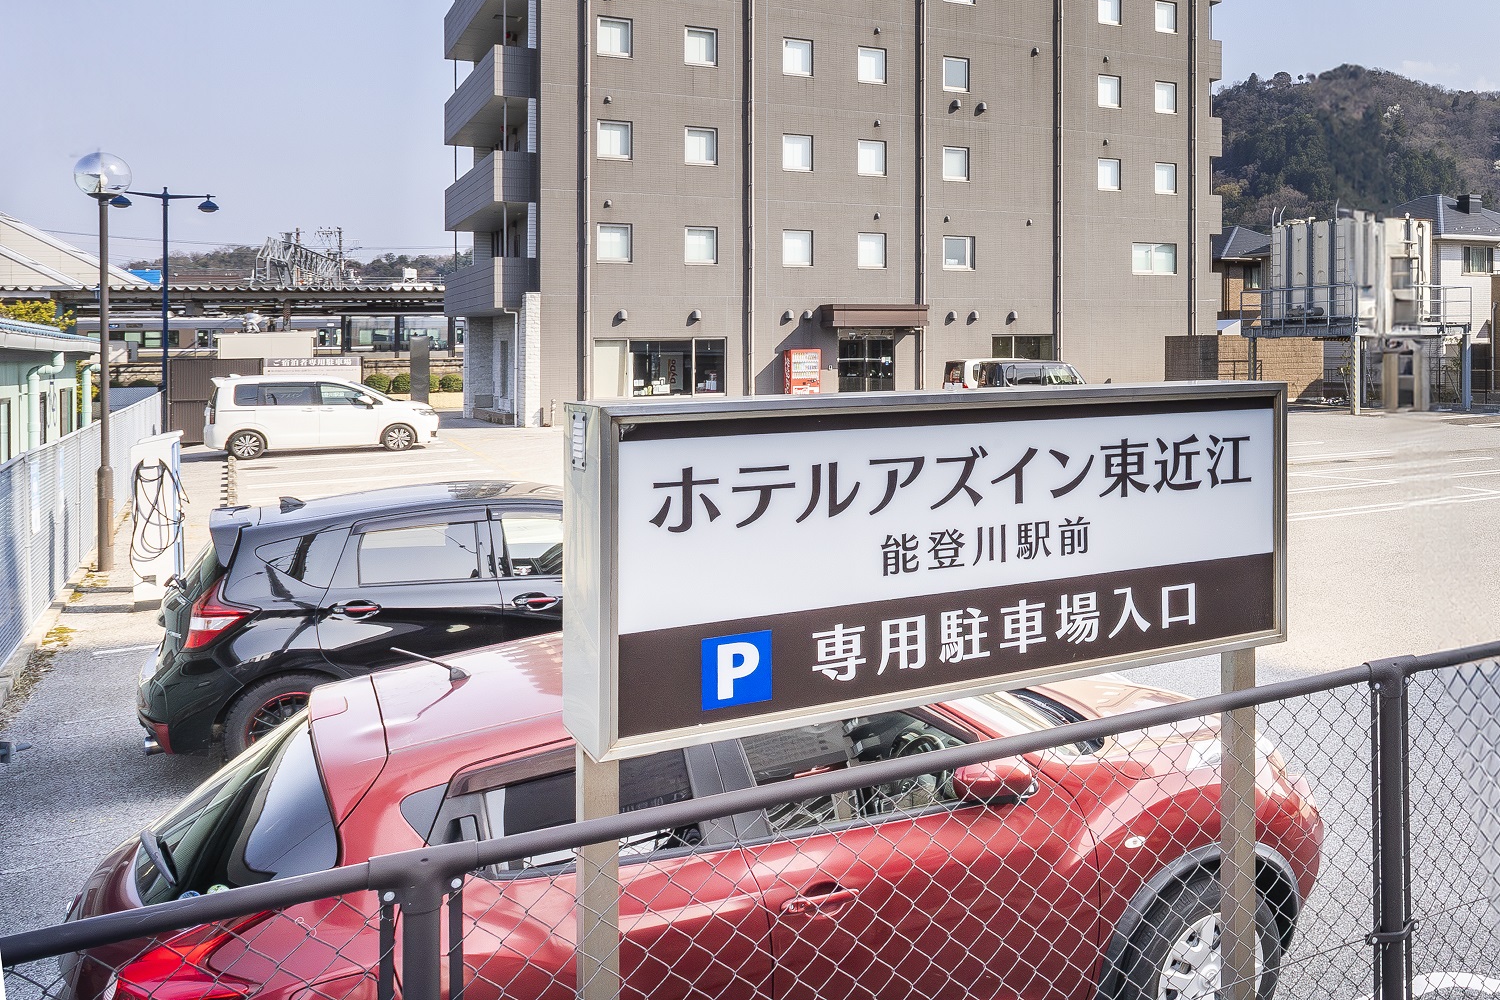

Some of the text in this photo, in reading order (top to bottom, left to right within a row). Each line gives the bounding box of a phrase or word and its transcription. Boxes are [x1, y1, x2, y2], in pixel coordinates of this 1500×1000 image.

[273, 358, 352, 366] ご宿泊者専用駐車場
[669, 359, 677, 384] DyDo
[648, 433, 1253, 534] ホテルアズイン東近江
[880, 515, 1091, 577] 能登川駅前
[811, 582, 1198, 682] 専用駐車場入口
[716, 641, 760, 701] P
